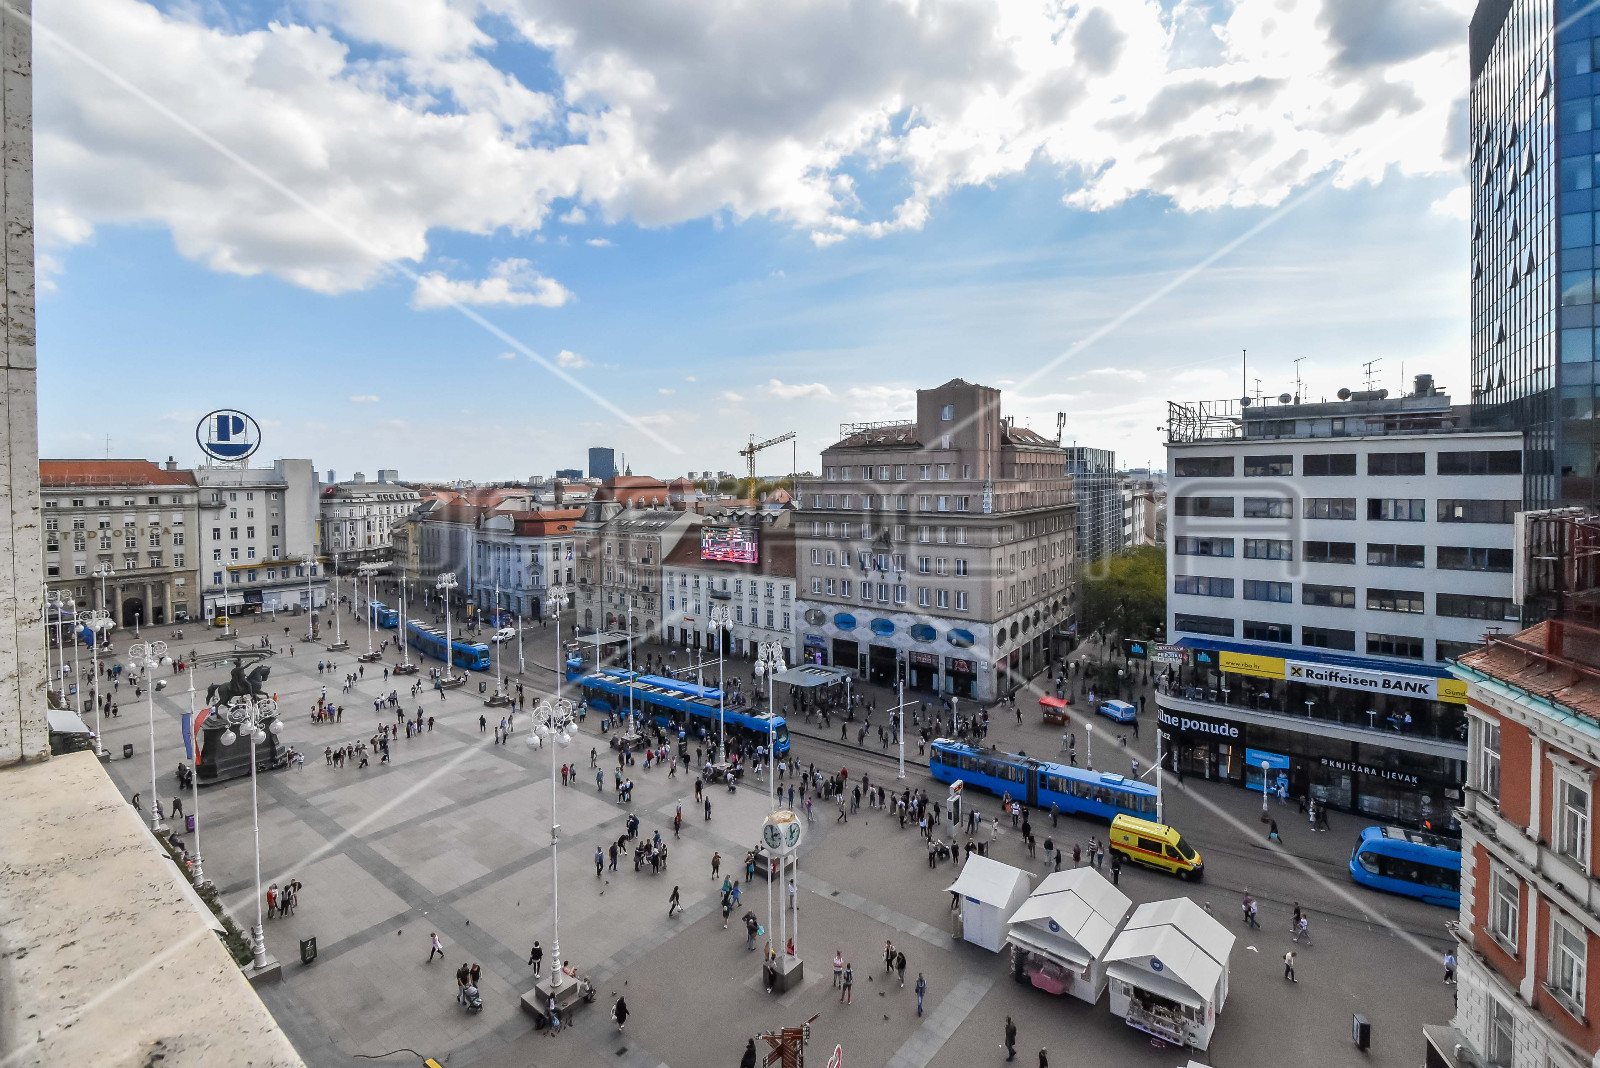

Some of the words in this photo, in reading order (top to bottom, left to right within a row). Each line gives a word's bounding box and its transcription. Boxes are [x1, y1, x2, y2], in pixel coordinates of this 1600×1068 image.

[1305, 668, 1378, 688] Raiffeisen
[1381, 679, 1431, 695] BANK
[1444, 688, 1467, 697] Gund
[1157, 708, 1179, 727] ilne
[1180, 716, 1239, 738] ponude
[1329, 759, 1377, 776] KNJIŽARA
[1381, 769, 1418, 784] LJEVAK
